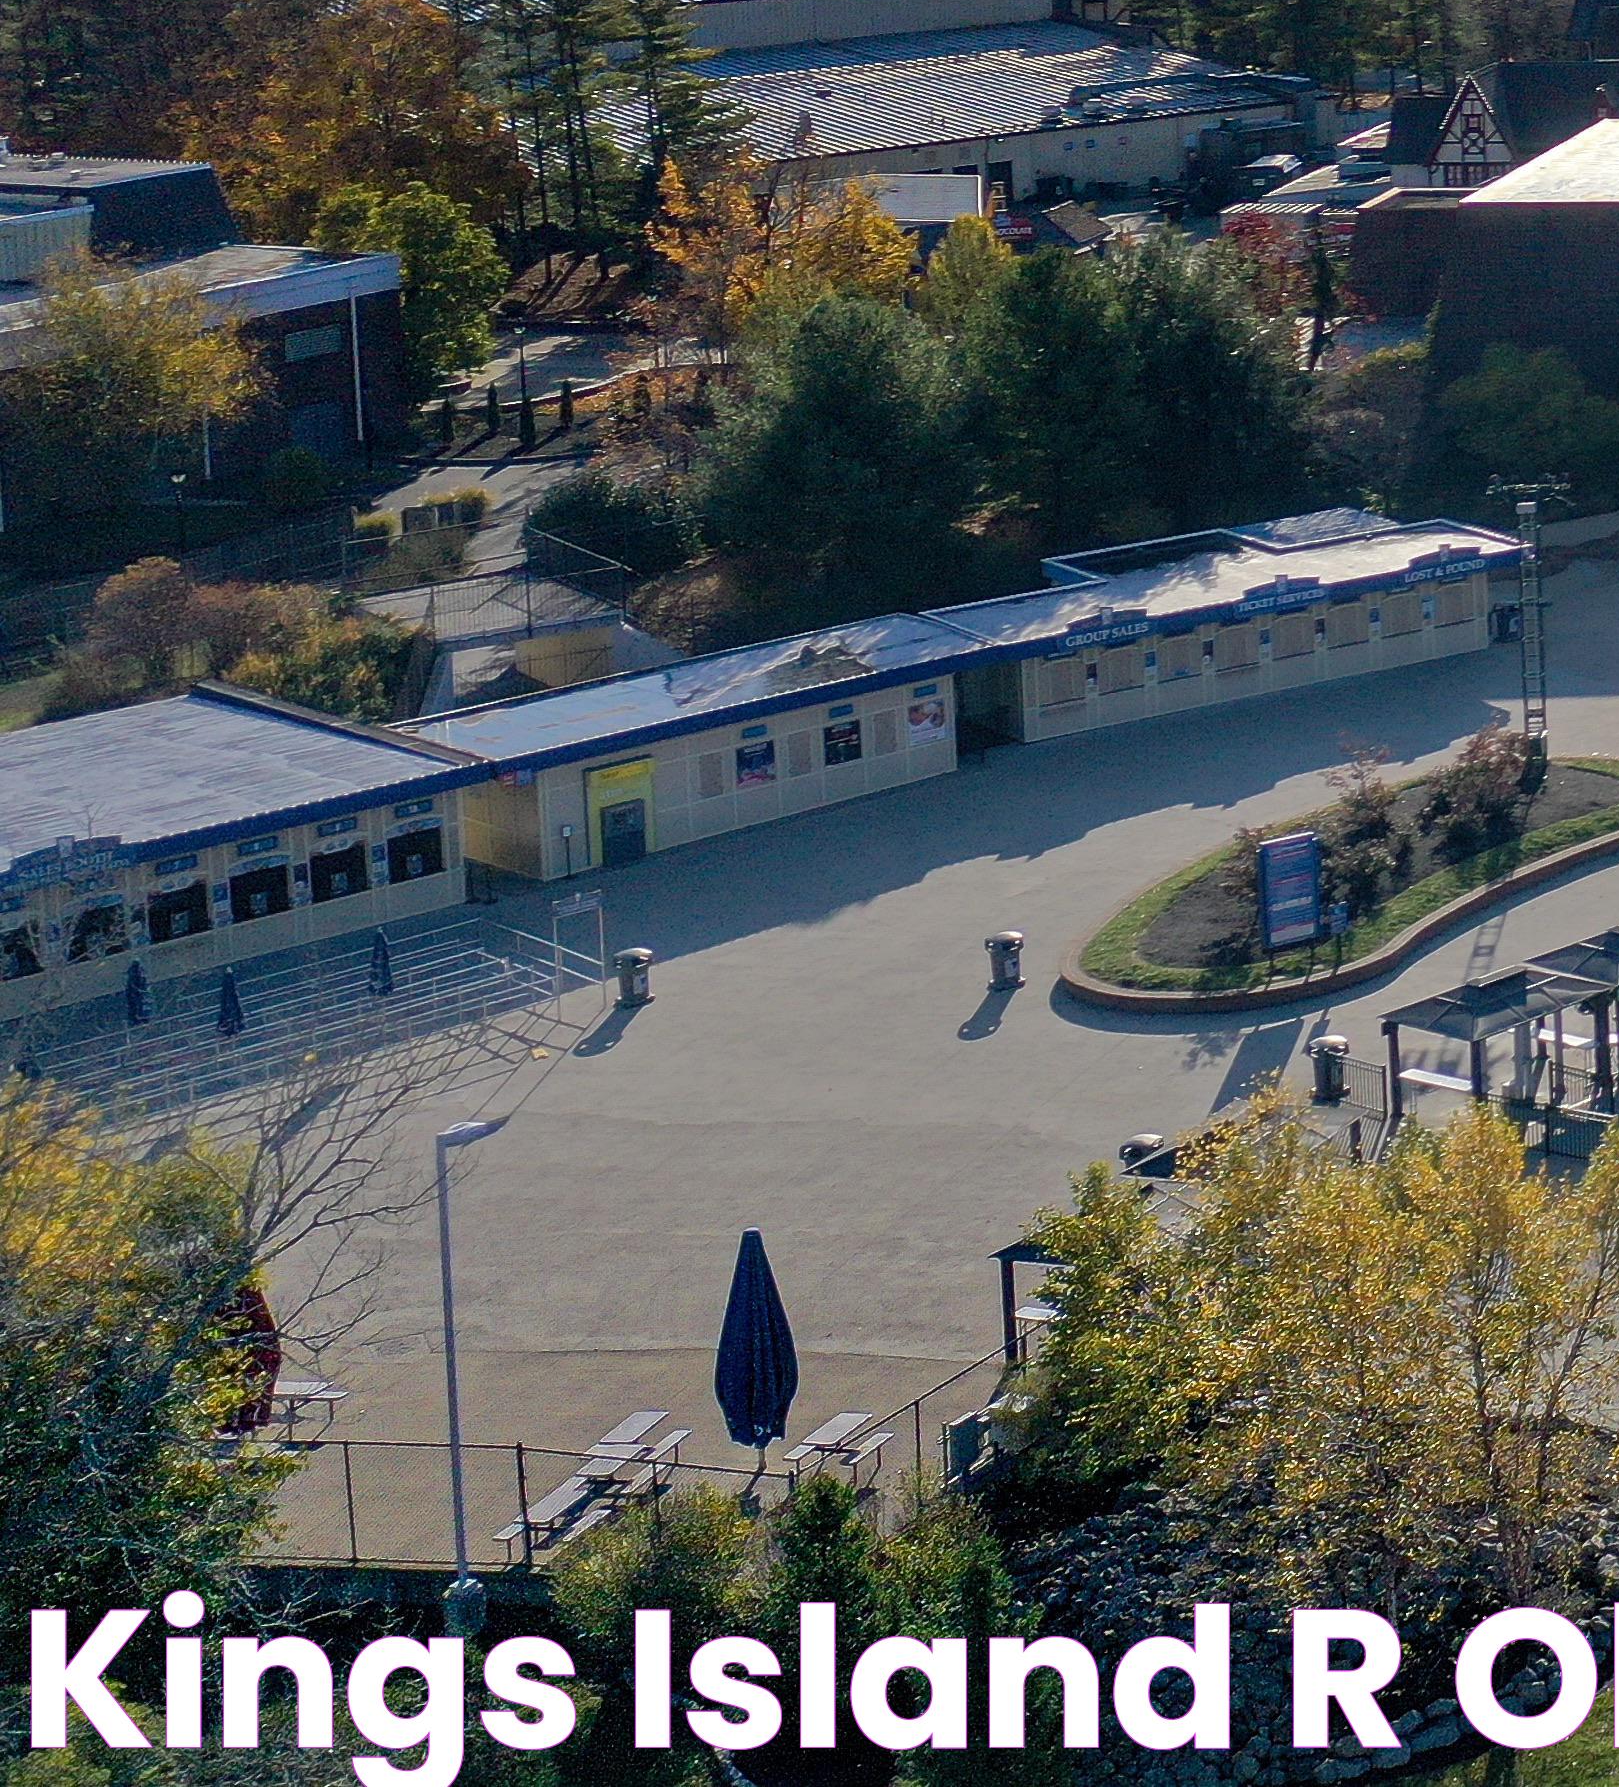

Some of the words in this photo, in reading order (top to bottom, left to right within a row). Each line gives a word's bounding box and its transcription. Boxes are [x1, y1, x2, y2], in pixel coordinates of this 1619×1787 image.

[1404, 568, 1434, 583] LOST
[1445, 558, 1486, 574] FOUND
[1237, 596, 1275, 613] TICKET
[1276, 587, 1326, 605] SERVICES
[1065, 628, 1110, 647] GROUP
[1111, 621, 1149, 638] SALES
